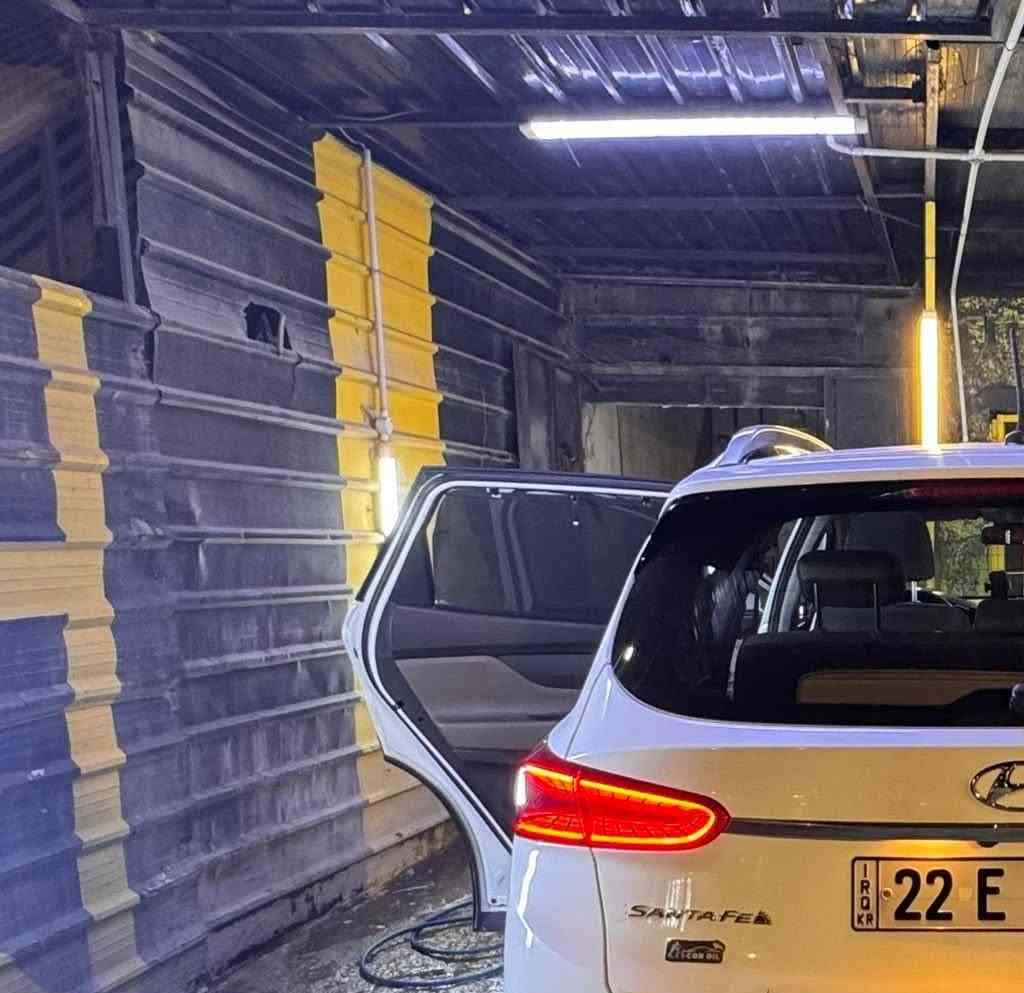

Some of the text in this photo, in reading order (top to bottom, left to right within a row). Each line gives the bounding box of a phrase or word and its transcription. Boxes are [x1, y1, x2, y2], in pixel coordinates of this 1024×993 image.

[894, 868, 953, 921] 22
[976, 868, 1006, 921] E
[856, 913, 874, 926] KR
